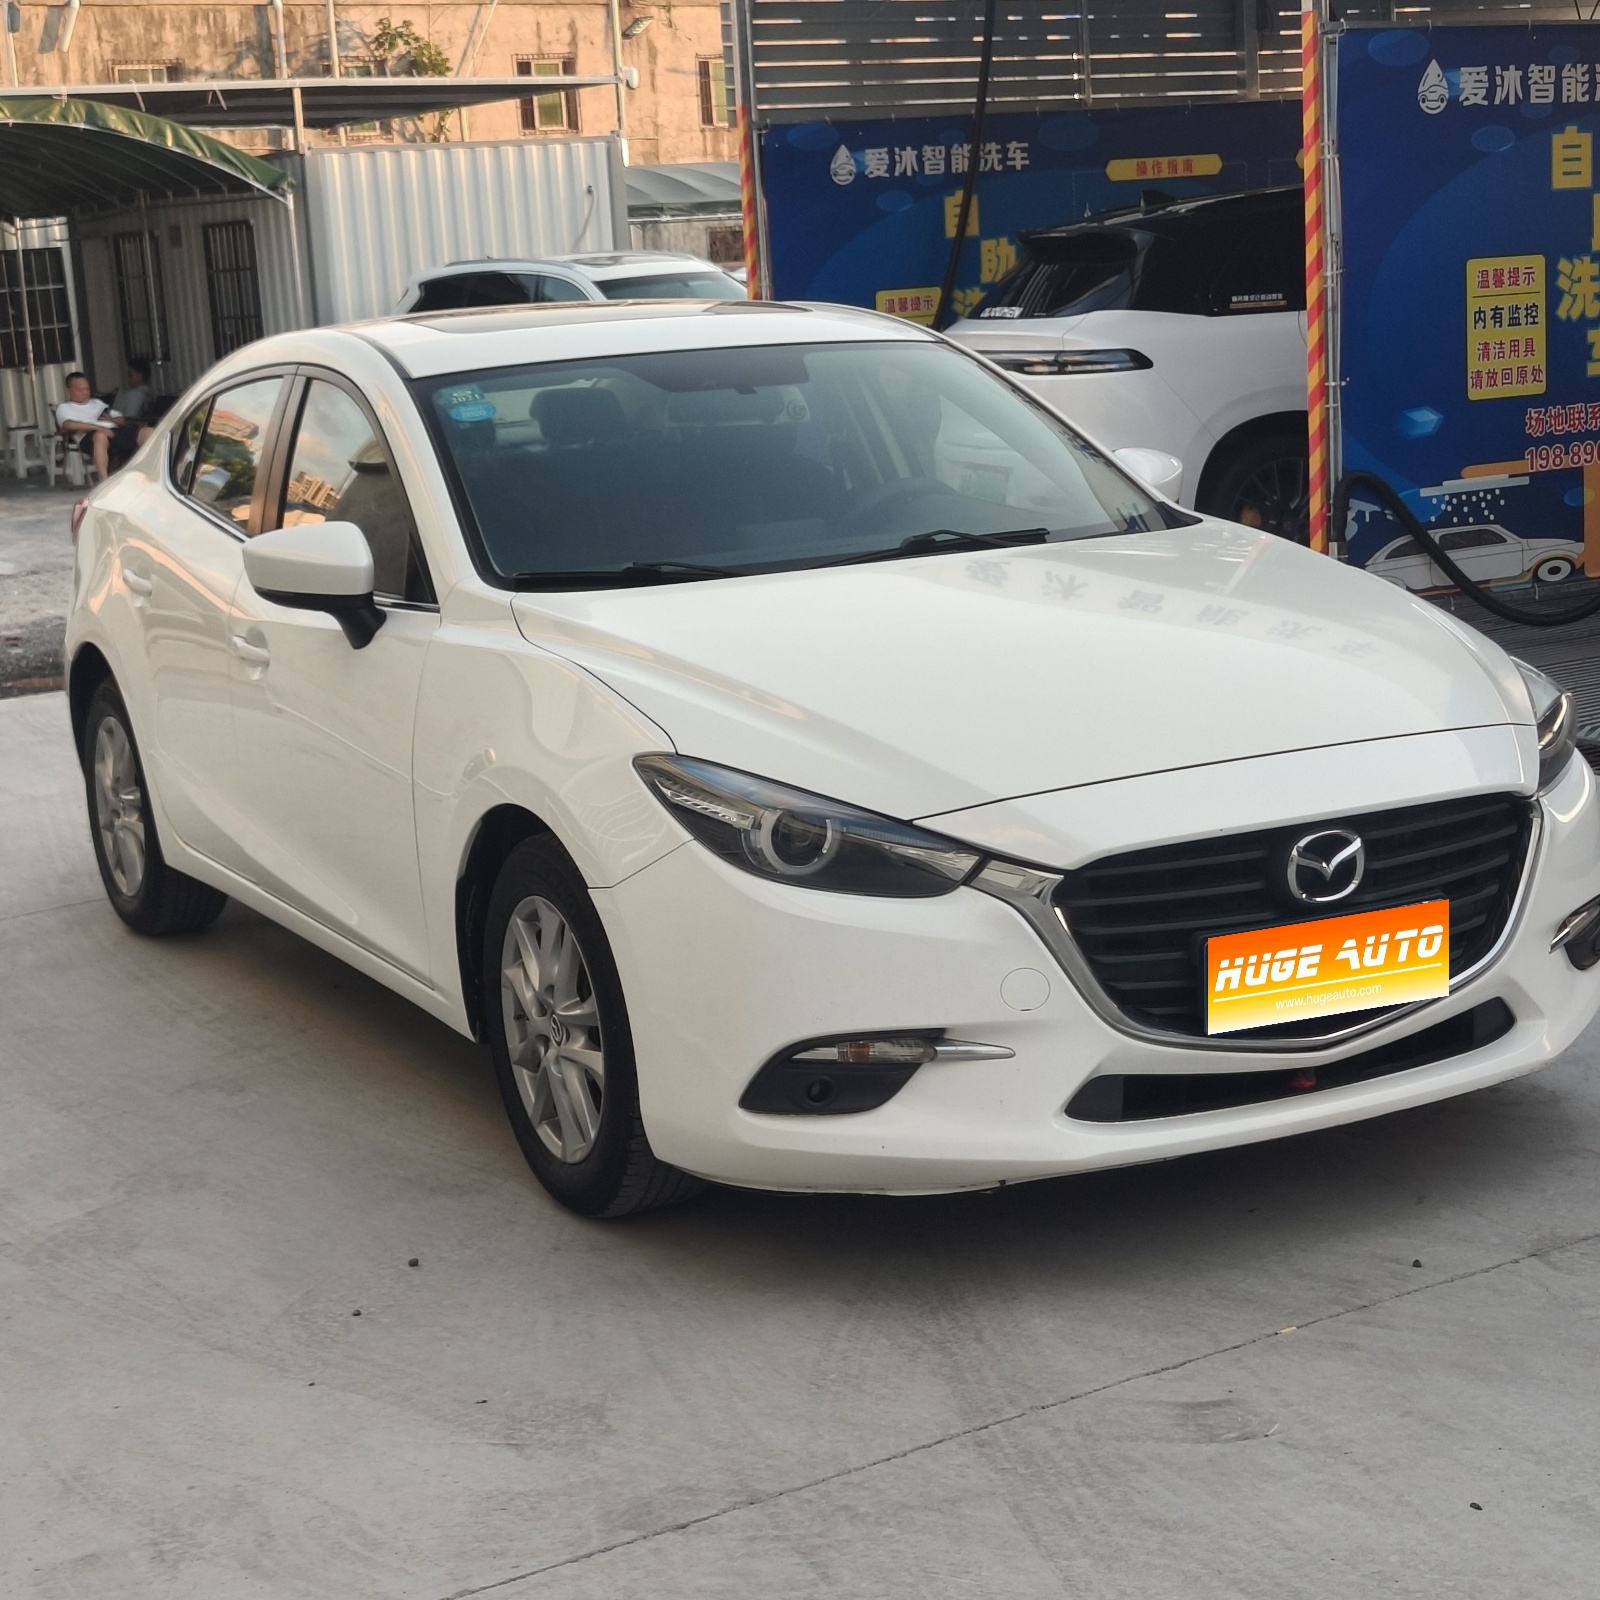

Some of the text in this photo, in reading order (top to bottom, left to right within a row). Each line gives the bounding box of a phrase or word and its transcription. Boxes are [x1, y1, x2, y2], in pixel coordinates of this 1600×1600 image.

[1458, 62, 1600, 107] 爱沐智能
[864, 141, 1030, 179] 爱沐智能洗车
[1136, 158, 1194, 177] 操作指南
[1476, 266, 1536, 290] 温馨提示
[884, 295, 934, 314] 温馨提示
[1473, 302, 1540, 331] 内有监控
[1477, 337, 1536, 362] 清洁用具
[1469, 364, 1544, 390] 请放回原处
[1525, 444, 1565, 473] 198
